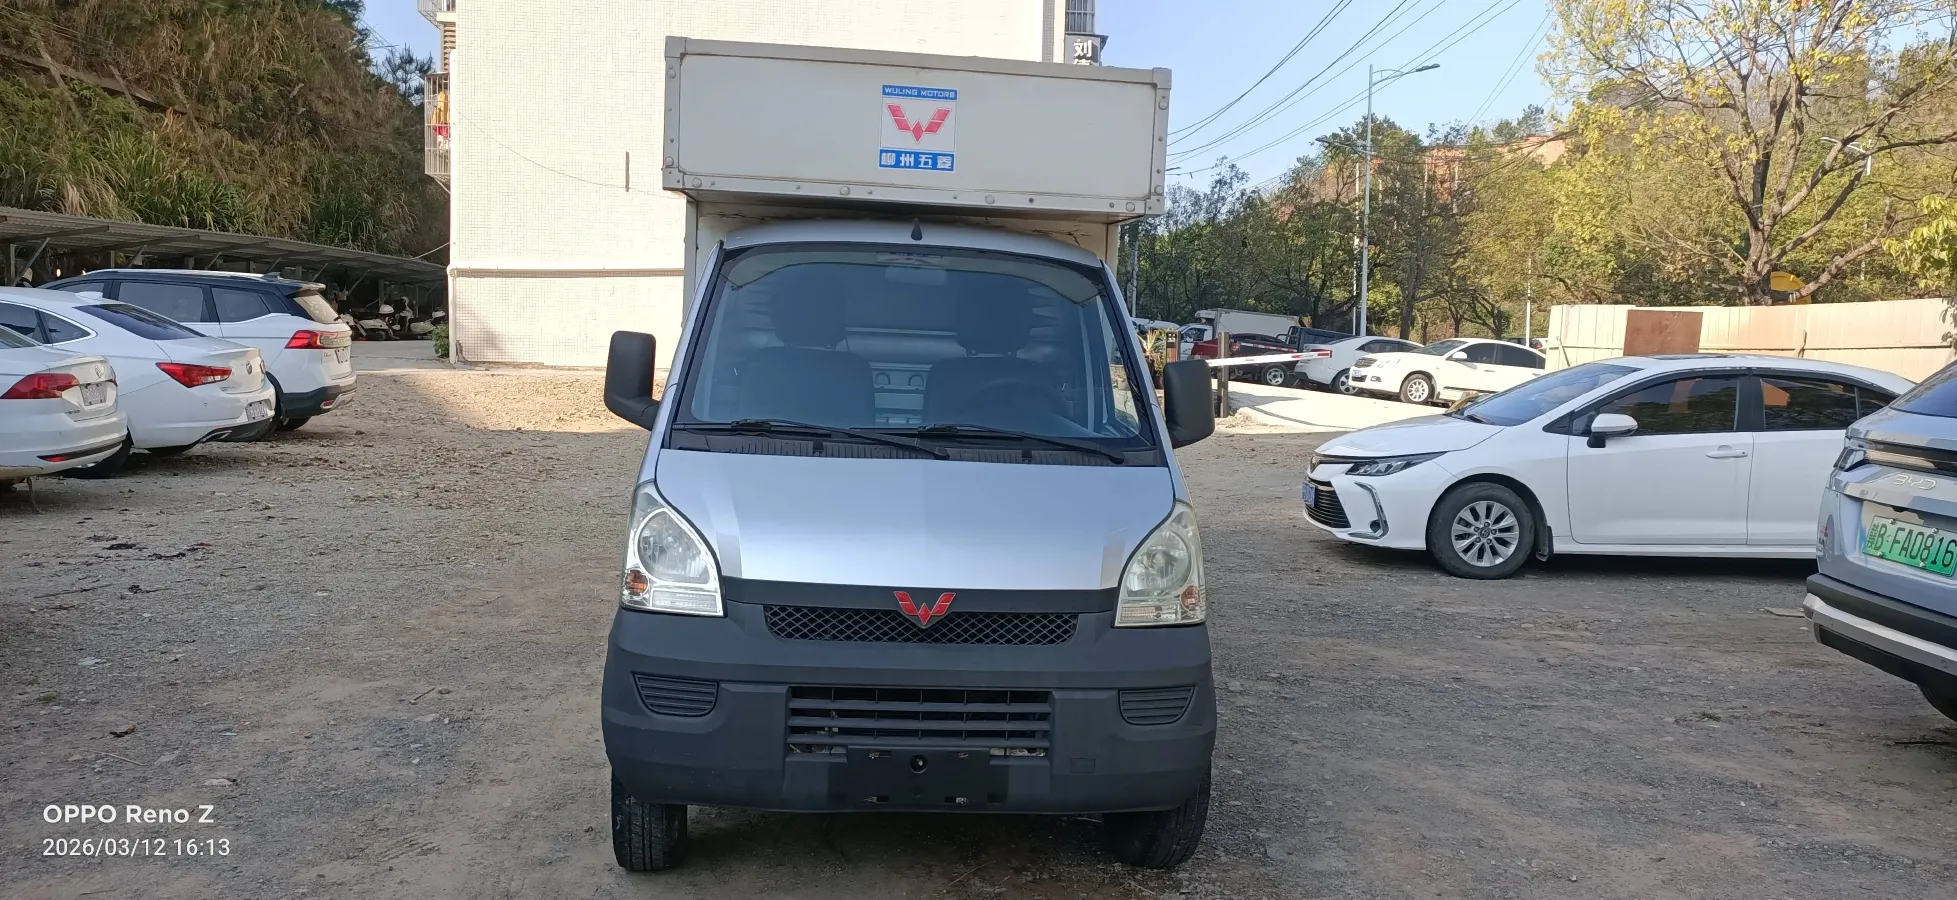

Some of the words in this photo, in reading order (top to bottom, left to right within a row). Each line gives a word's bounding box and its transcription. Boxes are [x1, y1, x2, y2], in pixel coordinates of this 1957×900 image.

[884, 87, 918, 96] WULING
[920, 90, 955, 98] MOTORS
[880, 152, 952, 169] 柳州五菱
